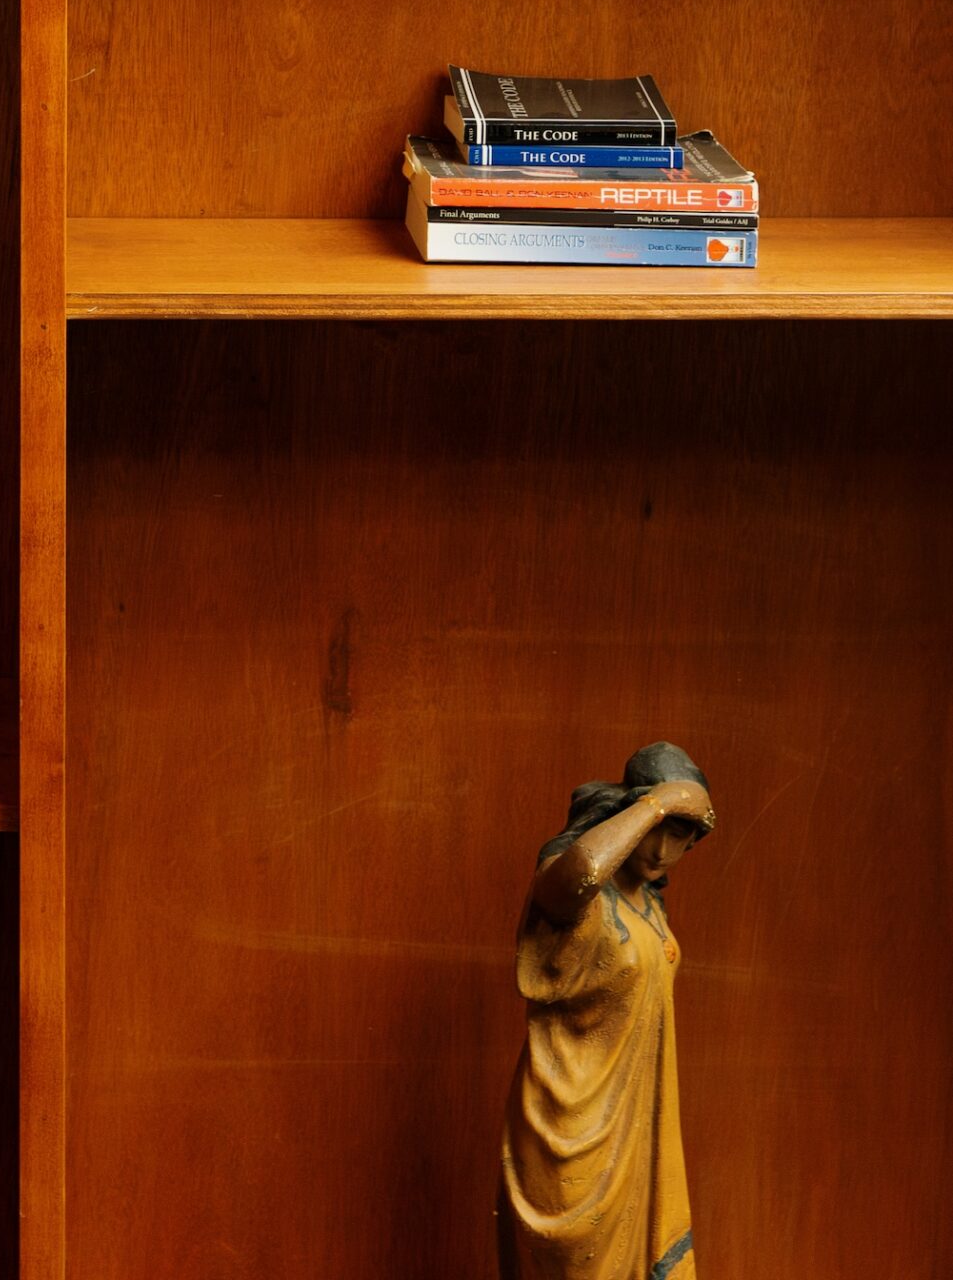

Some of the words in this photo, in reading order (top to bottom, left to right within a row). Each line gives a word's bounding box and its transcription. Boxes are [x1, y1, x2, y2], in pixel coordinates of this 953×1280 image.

[498, 78, 521, 102] CODE
[507, 102, 528, 118] THE
[514, 130, 539, 141] THE
[543, 130, 578, 141] CODE
[520, 151, 547, 163] THE
[550, 151, 586, 163] CODE
[438, 188, 471, 197] DAVID
[475, 189, 502, 198] BALL
[600, 188, 702, 205] REPTILE
[440, 209, 457, 219] Final
[460, 210, 500, 221] Arguments
[637, 216, 653, 225] Philip
[454, 232, 507, 246] CLOSING
[509, 234, 585, 247] ARGUMENTS
[648, 243, 663, 251] Don
[665, 243, 673, 251] C.
